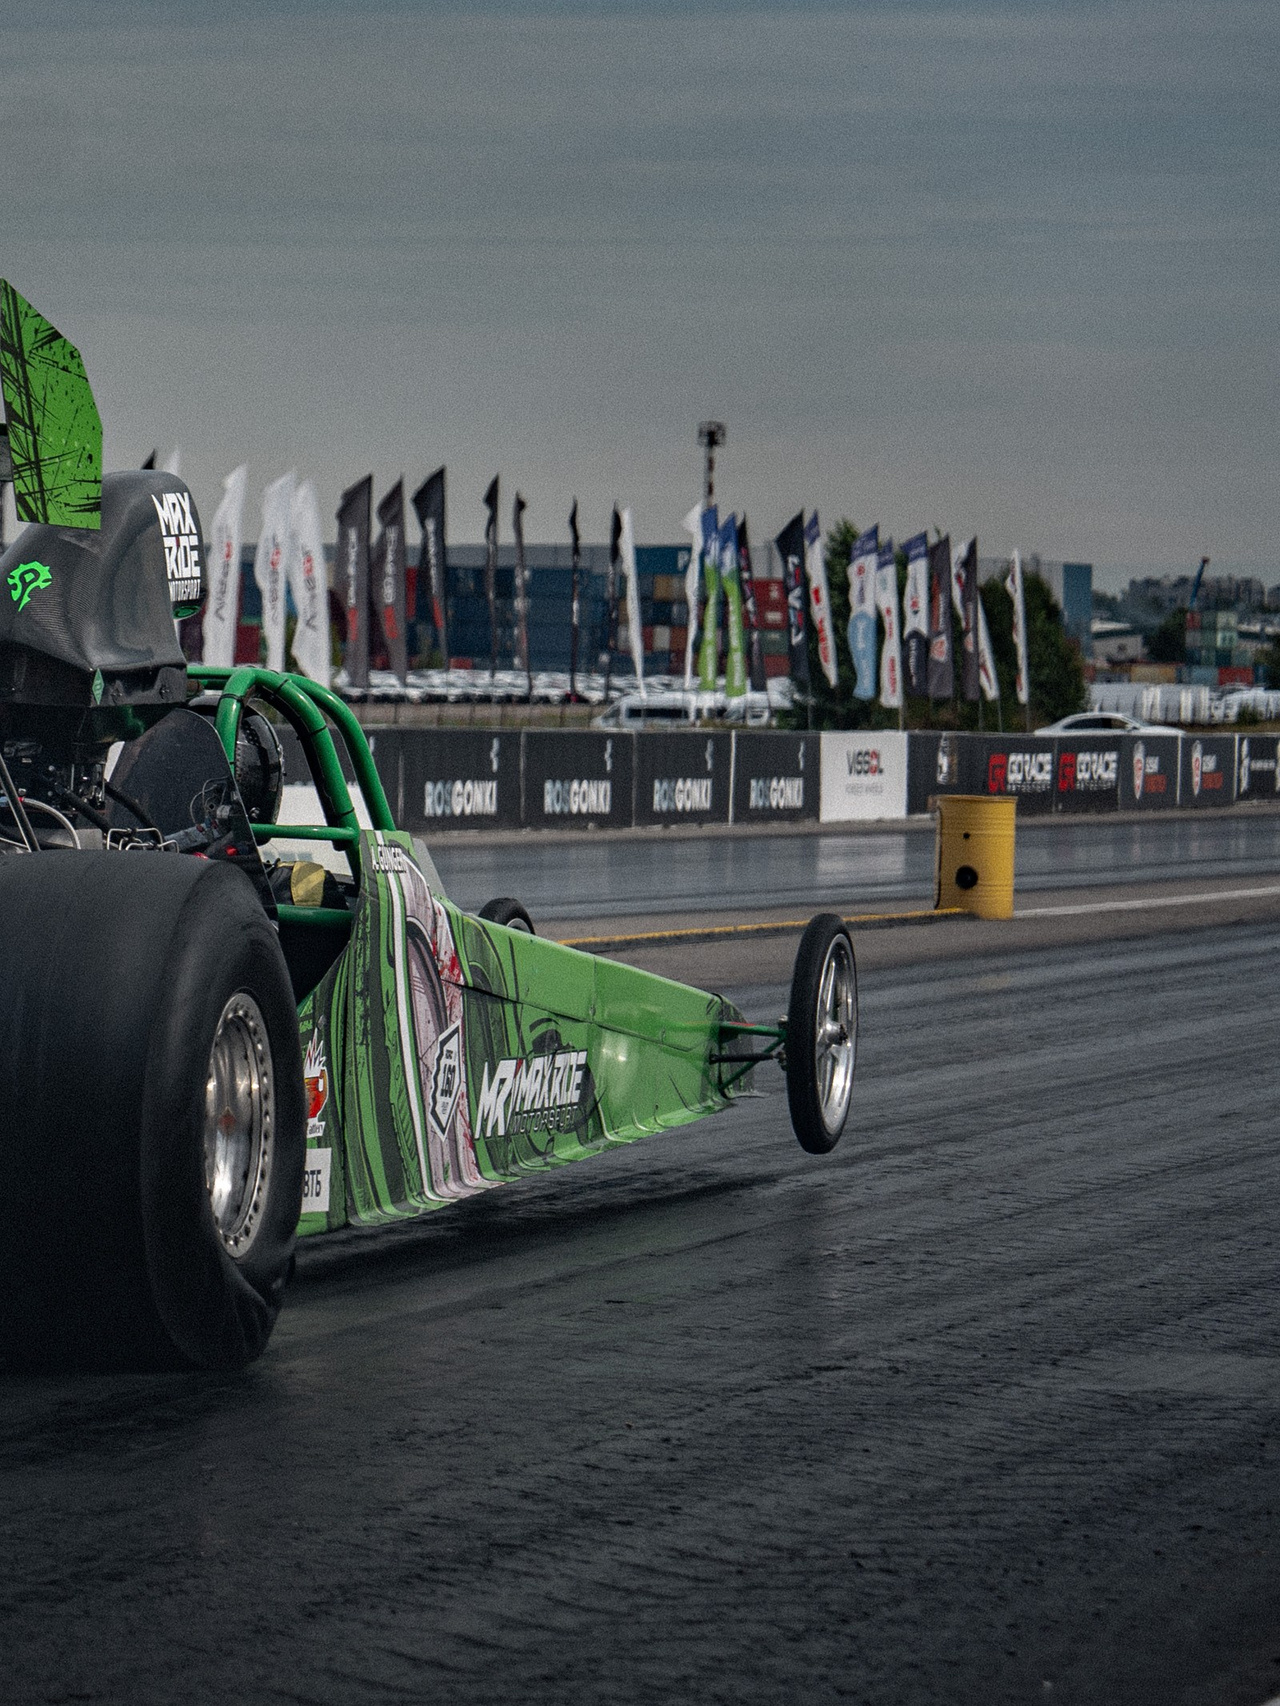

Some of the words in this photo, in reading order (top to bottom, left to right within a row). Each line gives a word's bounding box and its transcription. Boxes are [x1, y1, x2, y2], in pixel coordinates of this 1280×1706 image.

[151, 491, 198, 536] MAX
[424, 779, 498, 818] ROSGONKI
[543, 779, 612, 815] ROSGONKI
[652, 777, 713, 813] ROSGONKI
